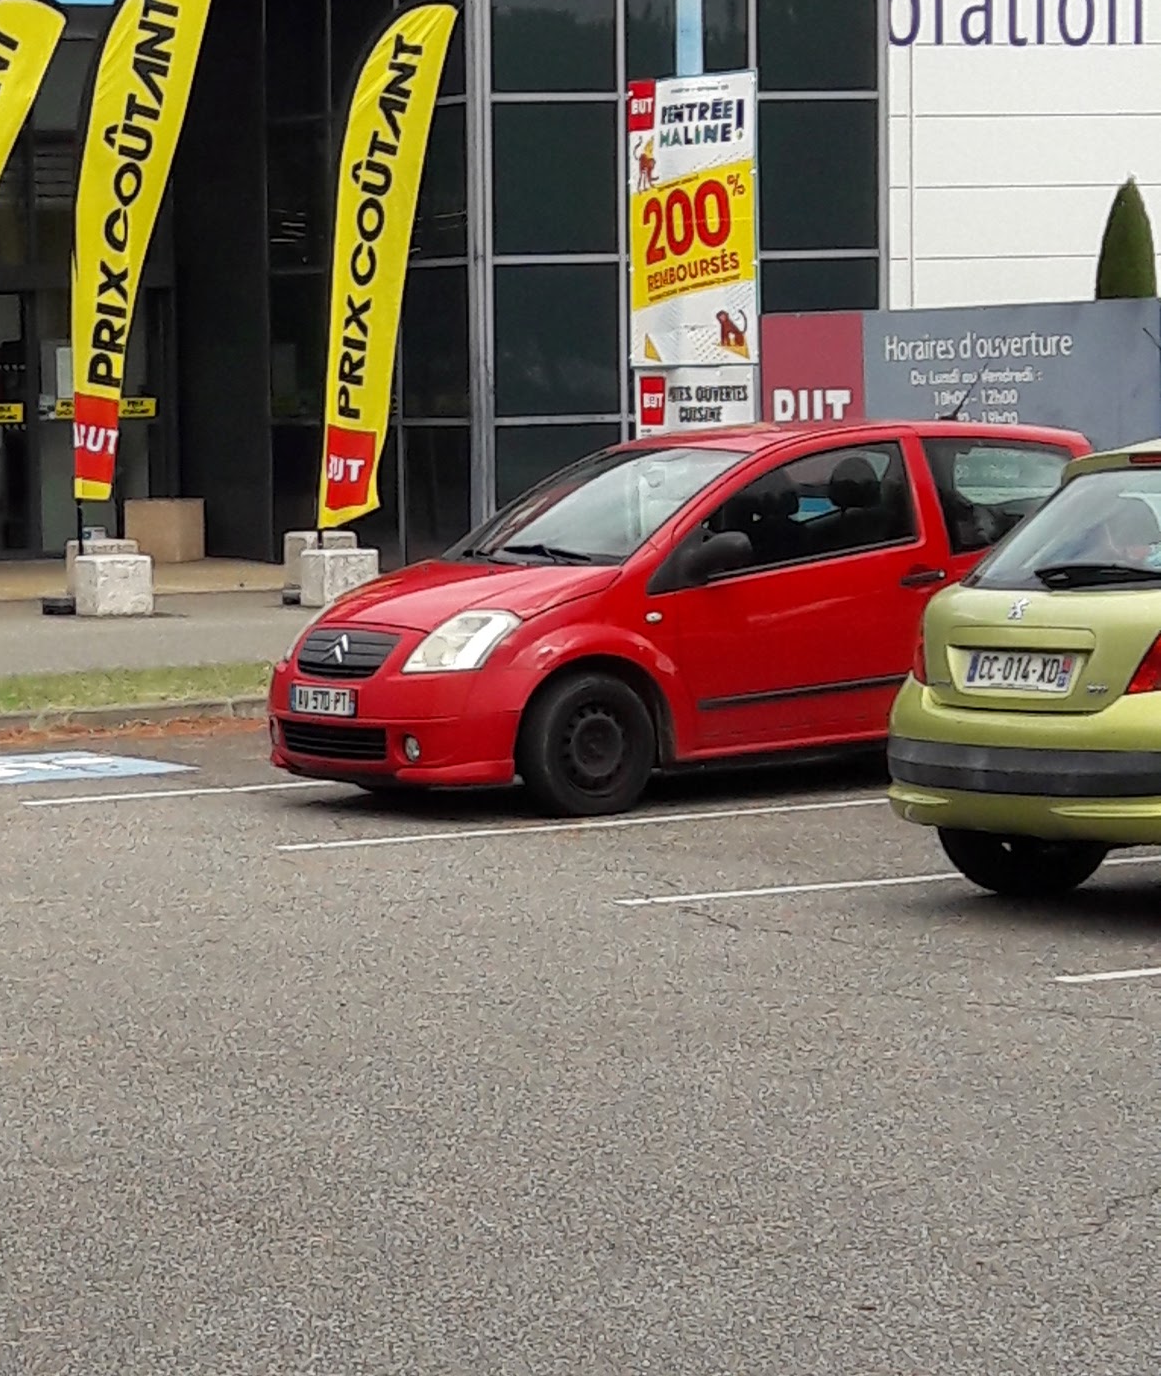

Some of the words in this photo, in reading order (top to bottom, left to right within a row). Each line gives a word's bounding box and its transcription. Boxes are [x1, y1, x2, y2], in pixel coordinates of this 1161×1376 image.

[350, 34, 424, 287] COÛTANT
[87, 260, 129, 388] PRIX
[338, 296, 372, 420] PRIX
[884, 334, 955, 362] Horaires
[959, 332, 1074, 359] d'ouverture
[978, 655, 1061, 683] CC-014-XD
